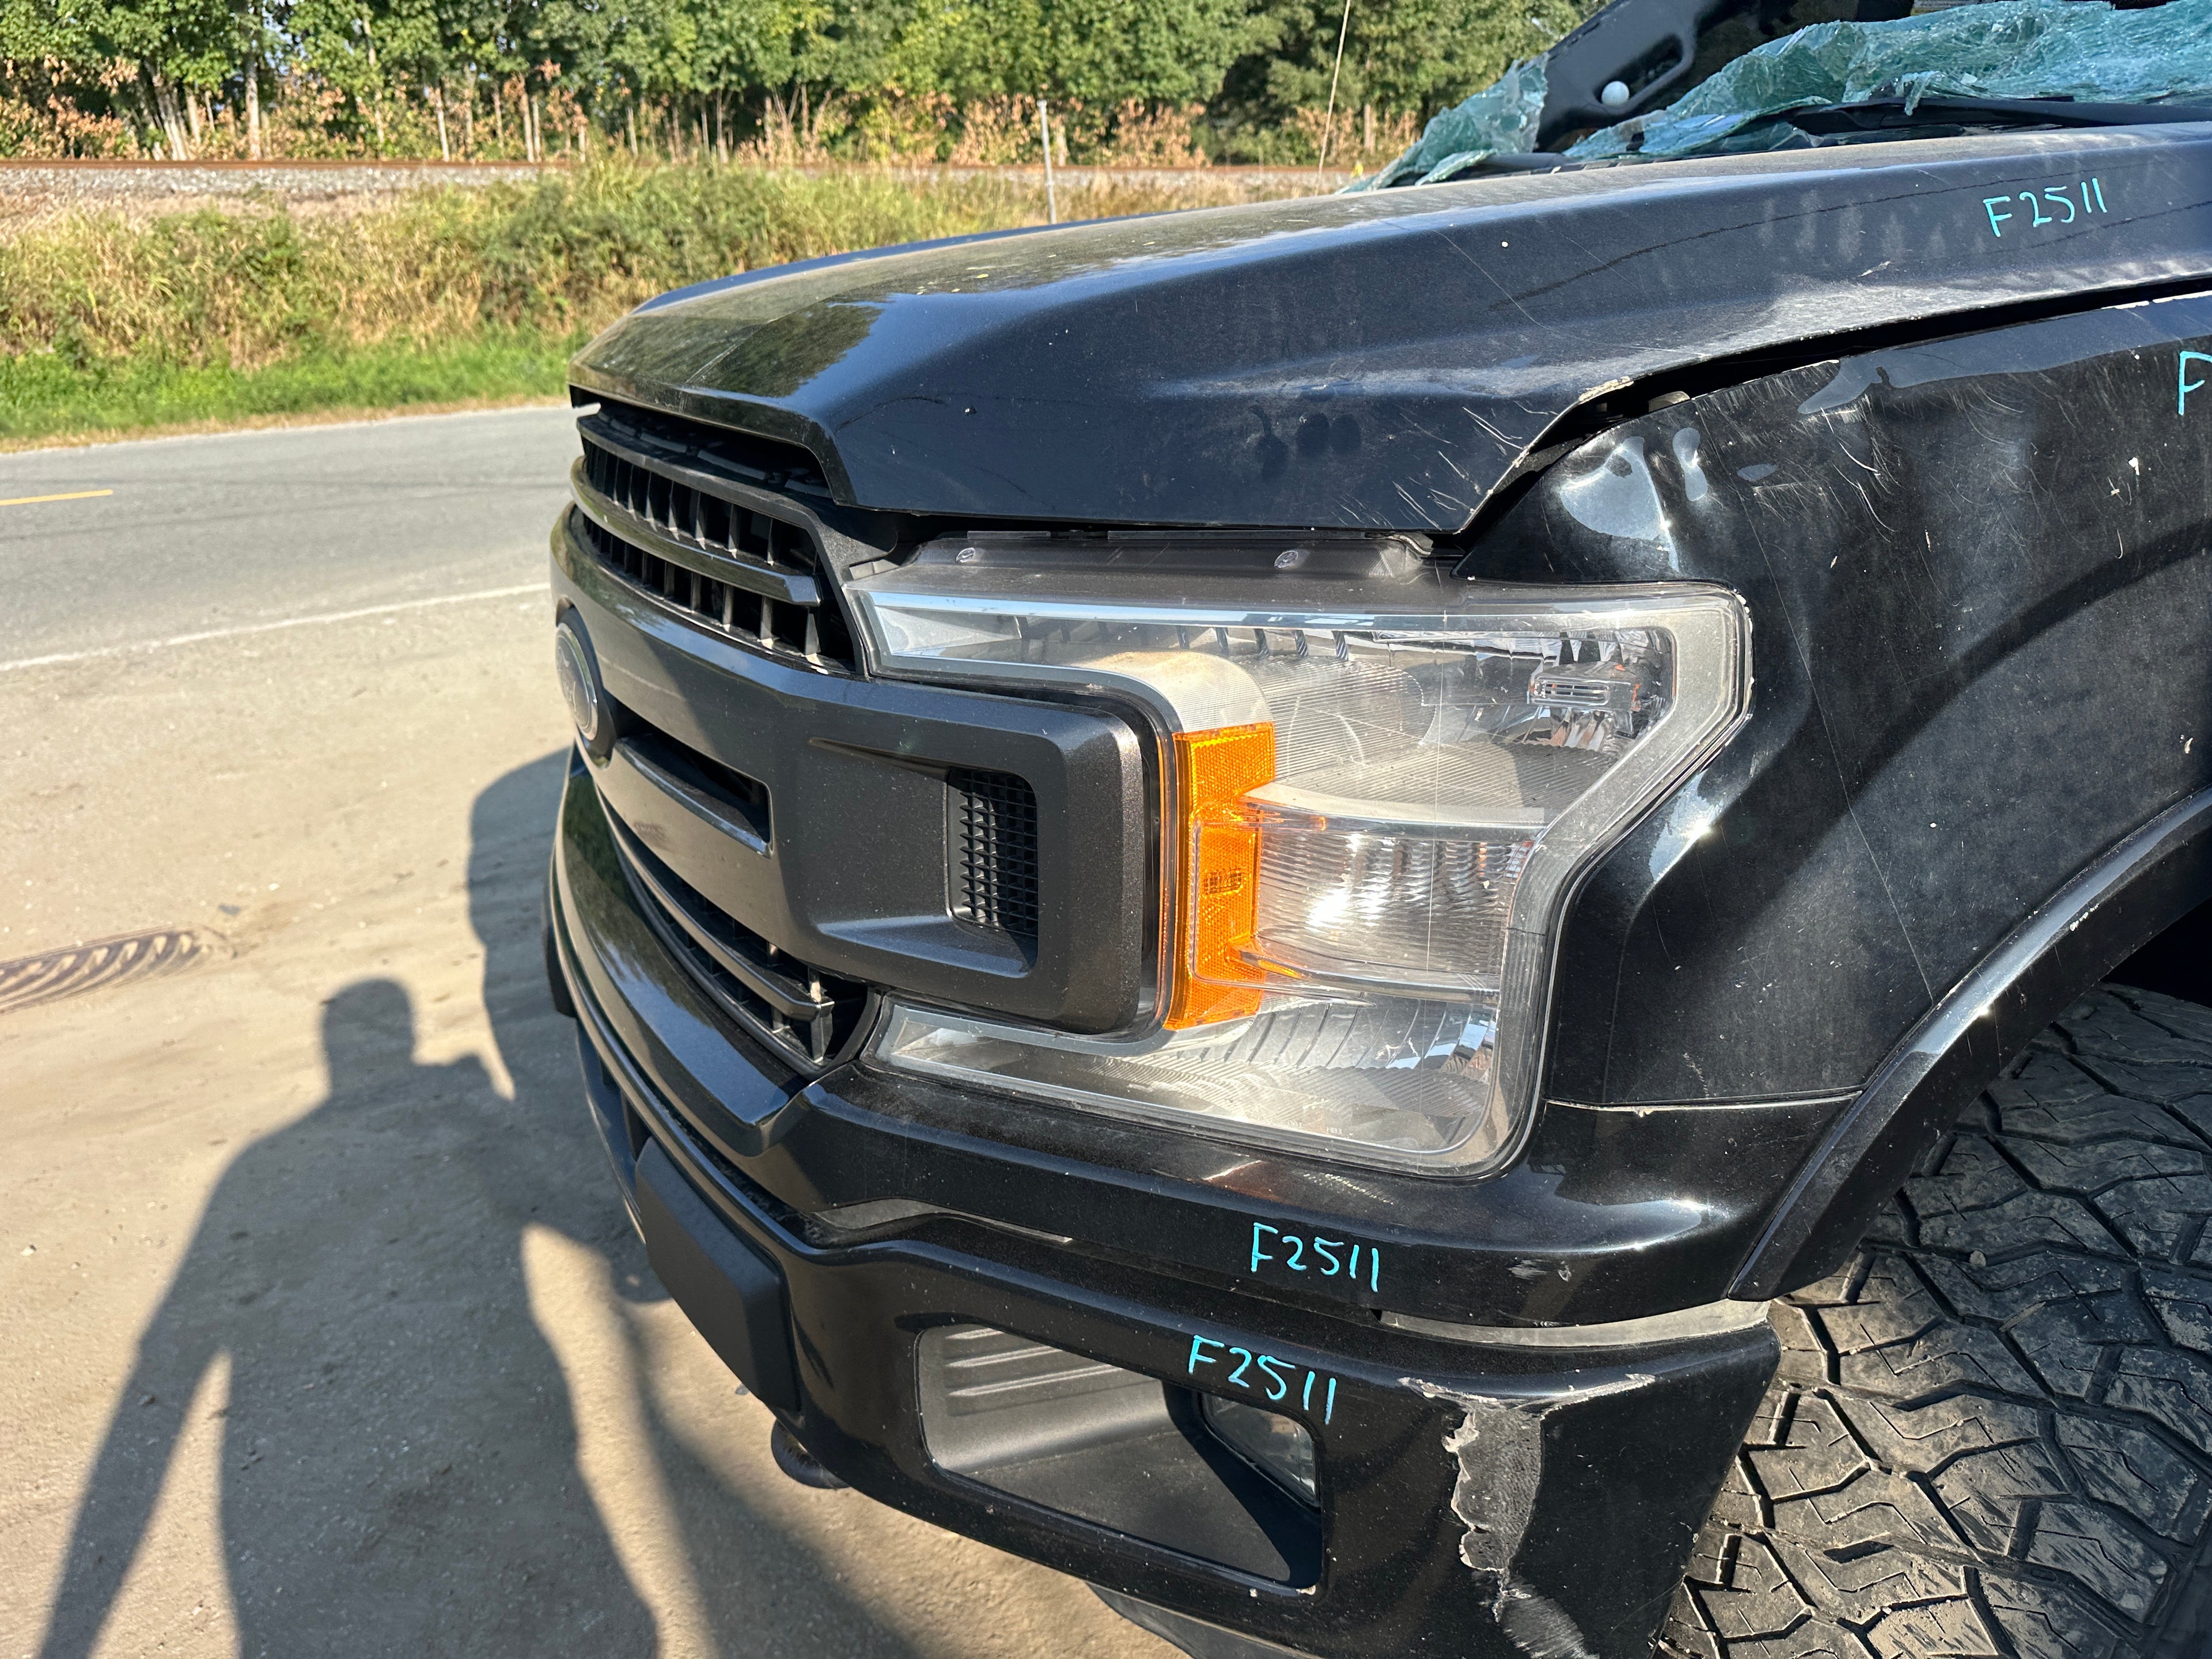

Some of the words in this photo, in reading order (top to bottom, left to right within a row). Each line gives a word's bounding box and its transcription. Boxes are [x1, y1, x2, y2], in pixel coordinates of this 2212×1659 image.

[1982, 177, 2108, 238] F2511
[1251, 1222, 1379, 1293] F2511
[1188, 1334, 1337, 1425] F2511
